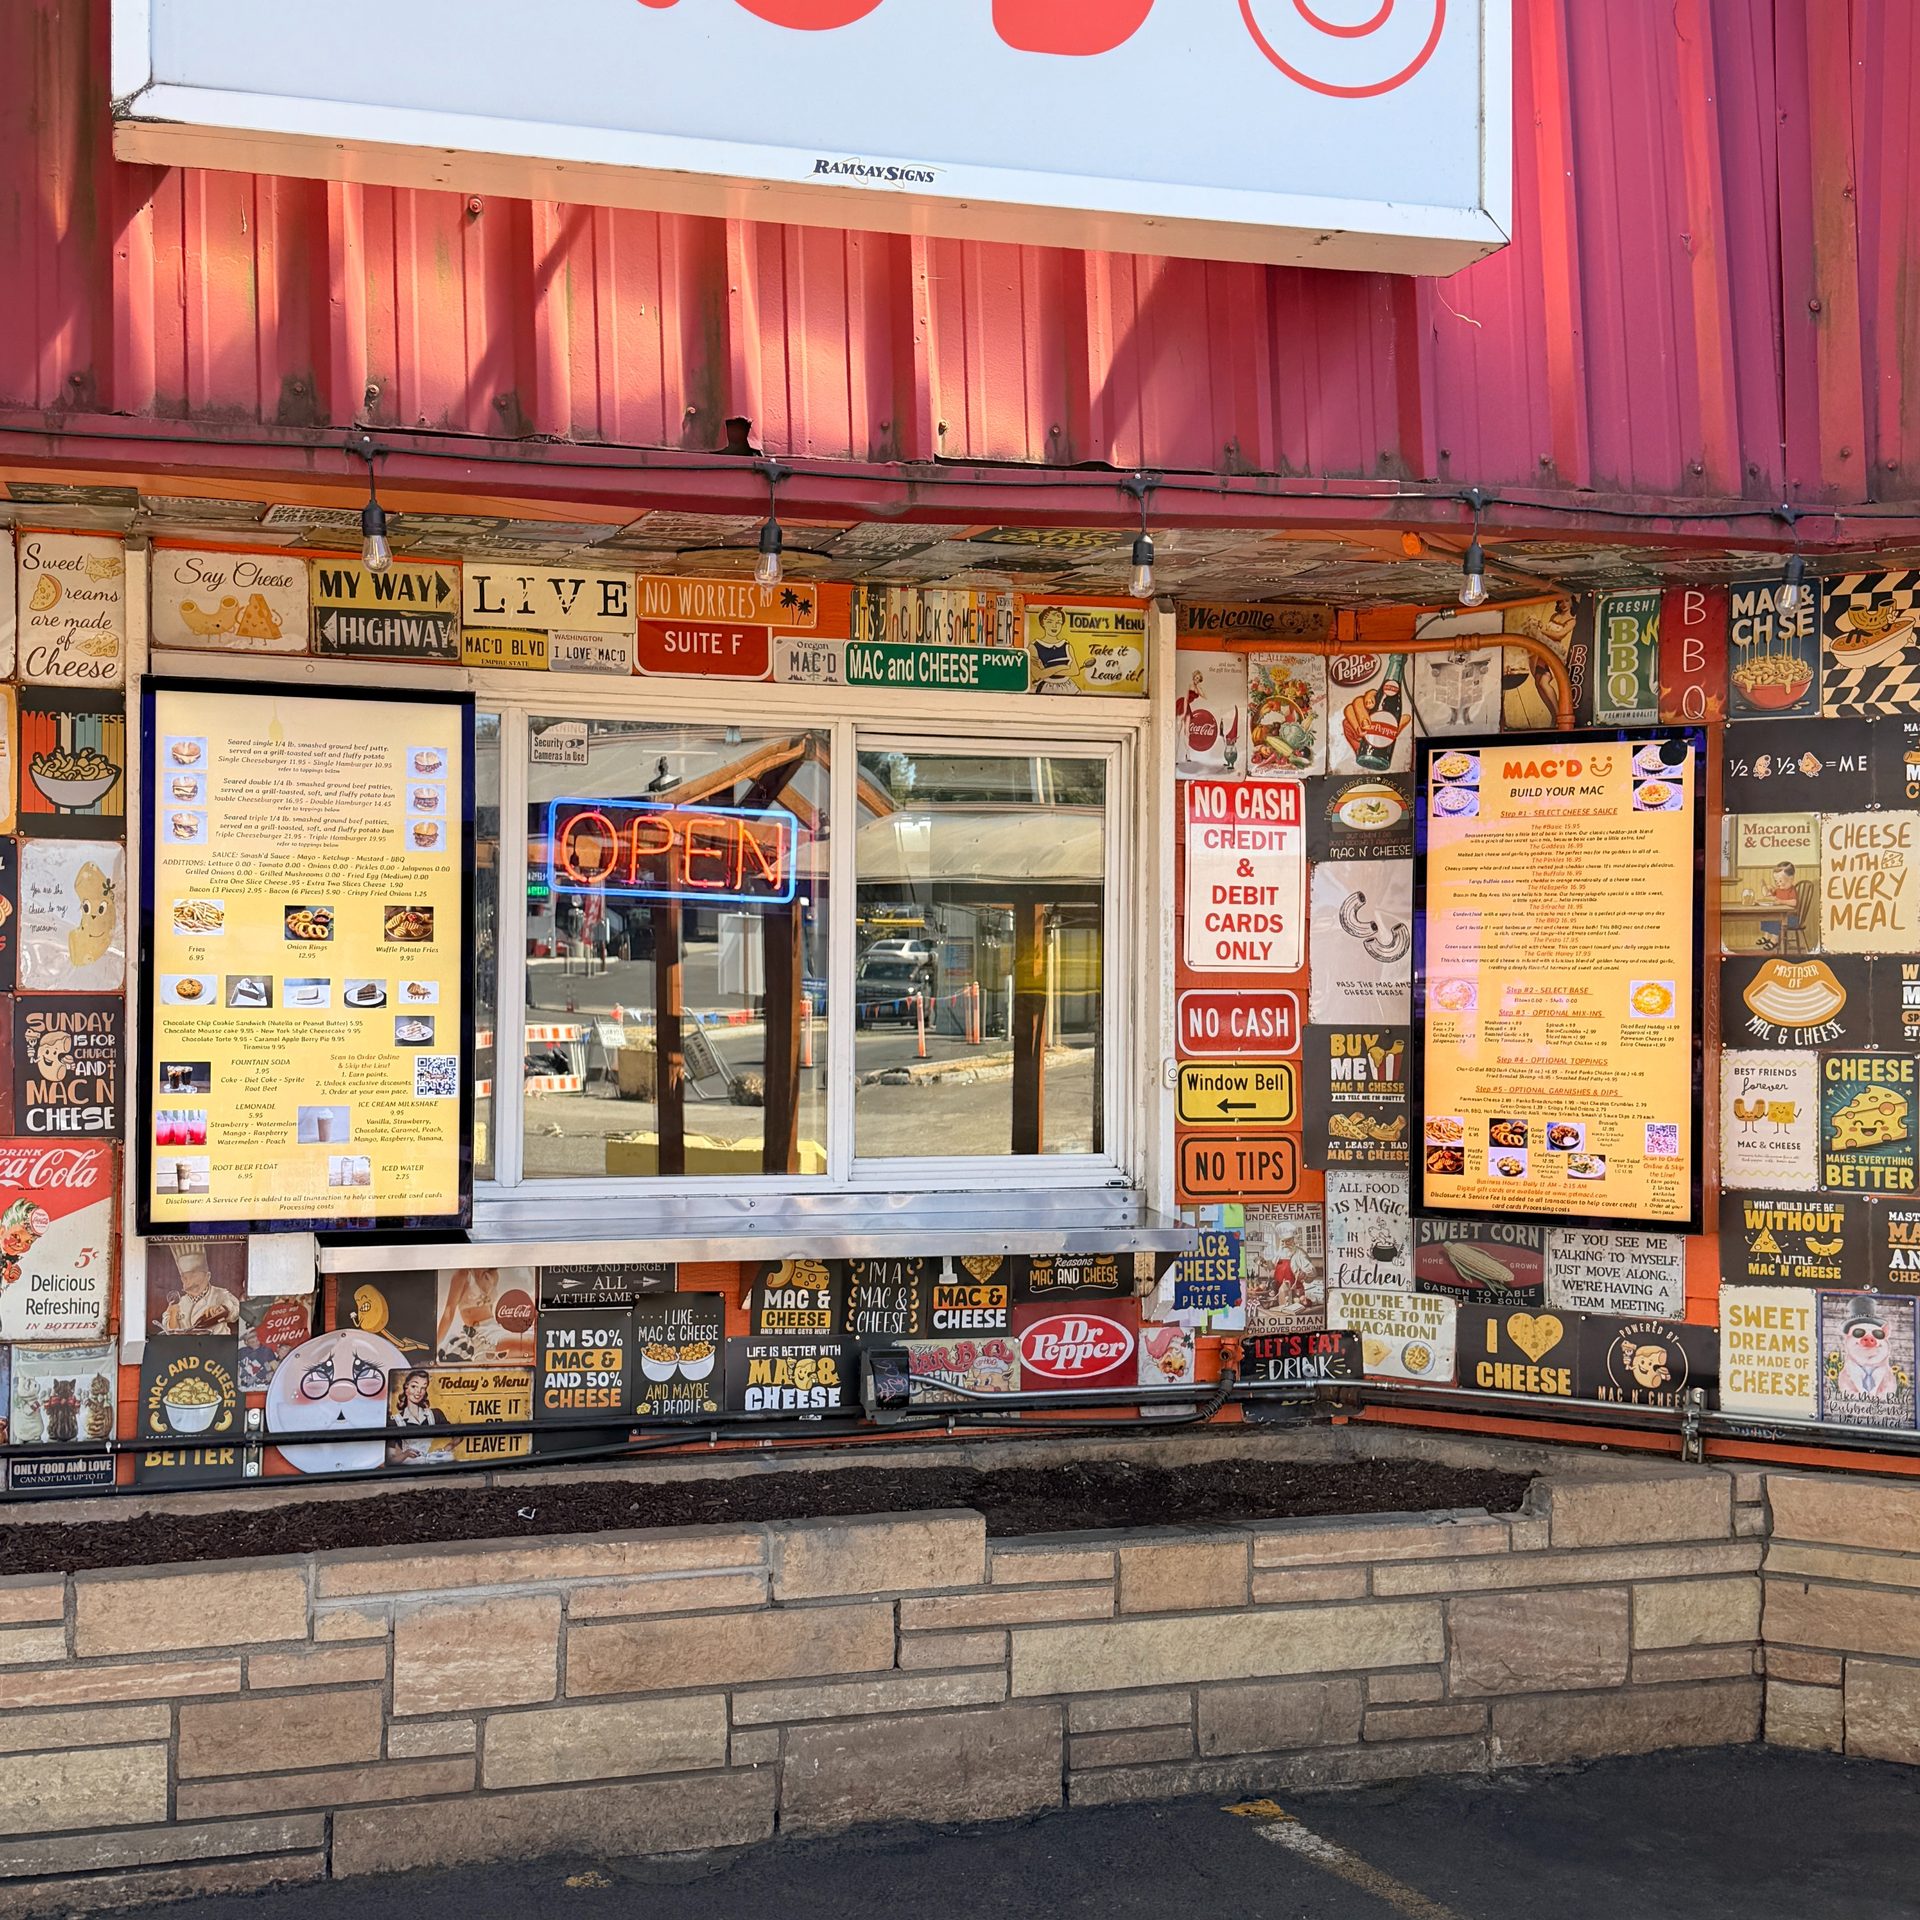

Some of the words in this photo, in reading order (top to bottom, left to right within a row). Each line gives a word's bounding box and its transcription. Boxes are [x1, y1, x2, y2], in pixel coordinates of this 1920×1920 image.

[22, 542, 84, 572] Sweet
[174, 557, 226, 592] Say
[232, 561, 293, 589] Cheese
[319, 570, 362, 600] MY
[370, 571, 432, 603] WAY
[472, 575, 629, 617] LIVE
[645, 583, 673, 616] NO
[677, 586, 757, 619] WORRIES
[760, 588, 773, 608] RD
[1608, 599, 1656, 613] FRESH!
[31, 614, 61, 628] are
[64, 613, 112, 631] made
[1068, 612, 1111, 630] TODAY'S
[1114, 614, 1146, 631] MENU
[1187, 606, 1275, 632] Welcome
[57, 631, 75, 648] of
[339, 615, 451, 648] HIGHWAY
[554, 633, 604, 643] WASHINGTON
[465, 636, 503, 655] MAC'D
[511, 639, 545, 657] BLVD
[664, 630, 721, 655] SUITE
[731, 634, 744, 656] F
[796, 641, 831, 651] Oregon
[1089, 643, 1115, 658] Take
[1117, 644, 1130, 658] it
[25, 646, 117, 679] Cheese
[554, 645, 560, 659] I
[565, 646, 593, 661] LOVE
[598, 648, 626, 663] MAC'D
[790, 652, 837, 674] MAC'D
[1105, 657, 1119, 669] or
[1609, 616, 1640, 709] BBQ
[1682, 591, 1706, 720] BBQ
[849, 650, 884, 681] MAC
[887, 656, 914, 682] and
[918, 652, 979, 684] CHEESE
[982, 653, 1025, 669] PKWY
[1091, 669, 1124, 682] Leave
[1124, 668, 1143, 683] it!
[1604, 711, 1633, 719] PREMIUM
[534, 737, 564, 749] Security
[533, 750, 563, 762] Cameras
[564, 752, 574, 762] In
[573, 752, 585, 763] Use
[1502, 759, 1583, 779] MAC'D
[1509, 788, 1543, 798] BUILD
[1546, 786, 1576, 796] YOUR
[1580, 785, 1605, 796] MAC
[1194, 786, 1226, 818] NO
[1234, 787, 1296, 821] CASH
[1534, 809, 1561, 817] SELECT
[1562, 808, 1591, 816] CHEESE
[1593, 807, 1618, 815] SAUCE
[1743, 822, 1812, 837] Macaroni
[1829, 822, 1912, 850] CHEESE
[1203, 829, 1287, 850] CREDIT
[1744, 836, 1756, 848] &
[1759, 836, 1812, 848] Cheese
[560, 809, 783, 891] OPEN
[1235, 858, 1255, 878] &
[1831, 853, 1879, 873] WITH
[1827, 867, 1908, 901] EVERY
[1211, 885, 1280, 906] DEBIT
[1205, 912, 1284, 934] CARDS
[1829, 902, 1906, 932] MEAL
[188, 945, 206, 953] Fries
[286, 943, 306, 951] Onion
[308, 943, 328, 952] Rings
[297, 952, 316, 960] 12.95
[1215, 940, 1273, 961] ONLY
[26, 1012, 115, 1032] SUNDAY
[1189, 1008, 1218, 1037] NO
[1231, 1008, 1289, 1038] CASH
[73, 1034, 87, 1046] IS
[90, 1034, 115, 1046] FOR
[74, 1048, 117, 1059] CHURCH
[231, 1058, 269, 1066] FOUNTAIN
[270, 1058, 291, 1066] SODA
[75, 1061, 106, 1077] AND
[1734, 1067, 1756, 1077] BEST
[1758, 1067, 1798, 1078] FRIENDS
[1825, 1058, 1914, 1083] CHEESE
[1186, 1073, 1249, 1092] Window
[1255, 1073, 1284, 1091] Bell
[1741, 1077, 1790, 1096] forever
[26, 1080, 89, 1105] MAC
[96, 1080, 115, 1104] N
[26, 1106, 116, 1131] CHEESE
[210, 1120, 250, 1129] Strawberry
[222, 1129, 248, 1137] Mango
[253, 1129, 289, 1137] Raspberry
[1736, 1140, 1758, 1150] MAC
[1759, 1140, 1768, 1150] &
[1769, 1141, 1801, 1150] CHEESE
[234, 1163, 254, 1171] BEER
[255, 1163, 279, 1171] FLOAT
[381, 1164, 399, 1172] ICED
[399, 1164, 425, 1172] WATER
[1196, 1152, 1225, 1181] NO
[1236, 1152, 1284, 1181] TIPS
[1825, 1154, 1856, 1166] MAKES
[1858, 1155, 1914, 1167] EVERYTHING
[1825, 1165, 1915, 1189] BETTER
[1753, 1200, 1777, 1212] WHAT
[1778, 1201, 1802, 1212] WOULD
[1804, 1201, 1821, 1212] LIFE
[1823, 1202, 1834, 1212] BE
[1744, 1212, 1844, 1234] WITHOUT
[1420, 1223, 1482, 1245] SWEET
[1489, 1224, 1540, 1249] CORN
[1563, 1234, 1578, 1247] IF
[1582, 1234, 1610, 1247] YOU
[1615, 1236, 1640, 1249] SEE
[1645, 1236, 1668, 1250] ME
[1422, 1257, 1444, 1265] HOME
[1509, 1262, 1538, 1270] GROWN
[31, 1274, 96, 1293] Delicious
[25, 1297, 100, 1319] Refreshing
[1570, 1296, 1606, 1309] TEAM
[1612, 1298, 1665, 1313] MEETING
[266, 1314, 301, 1329] SOUP
[1729, 1305, 1810, 1331] SWEET
[265, 1329, 306, 1345] LUNCH
[546, 1329, 578, 1348] I'M
[581, 1329, 624, 1348] 50%
[1061, 1319, 1104, 1345] Dr
[1028, 1333, 1124, 1370] Pepper
[1729, 1331, 1810, 1354] DREAMS
[552, 1352, 595, 1369] MAC
[601, 1351, 617, 1367] &
[1729, 1353, 1752, 1367] ARE
[1756, 1354, 1791, 1368] MADE
[1794, 1357, 1810, 1369] OF
[544, 1373, 582, 1389] AND
[586, 1372, 623, 1388] 50%
[1476, 1361, 1573, 1396] CHEESE
[1728, 1369, 1810, 1398] CHEESE
[544, 1388, 622, 1409] CHEESE
